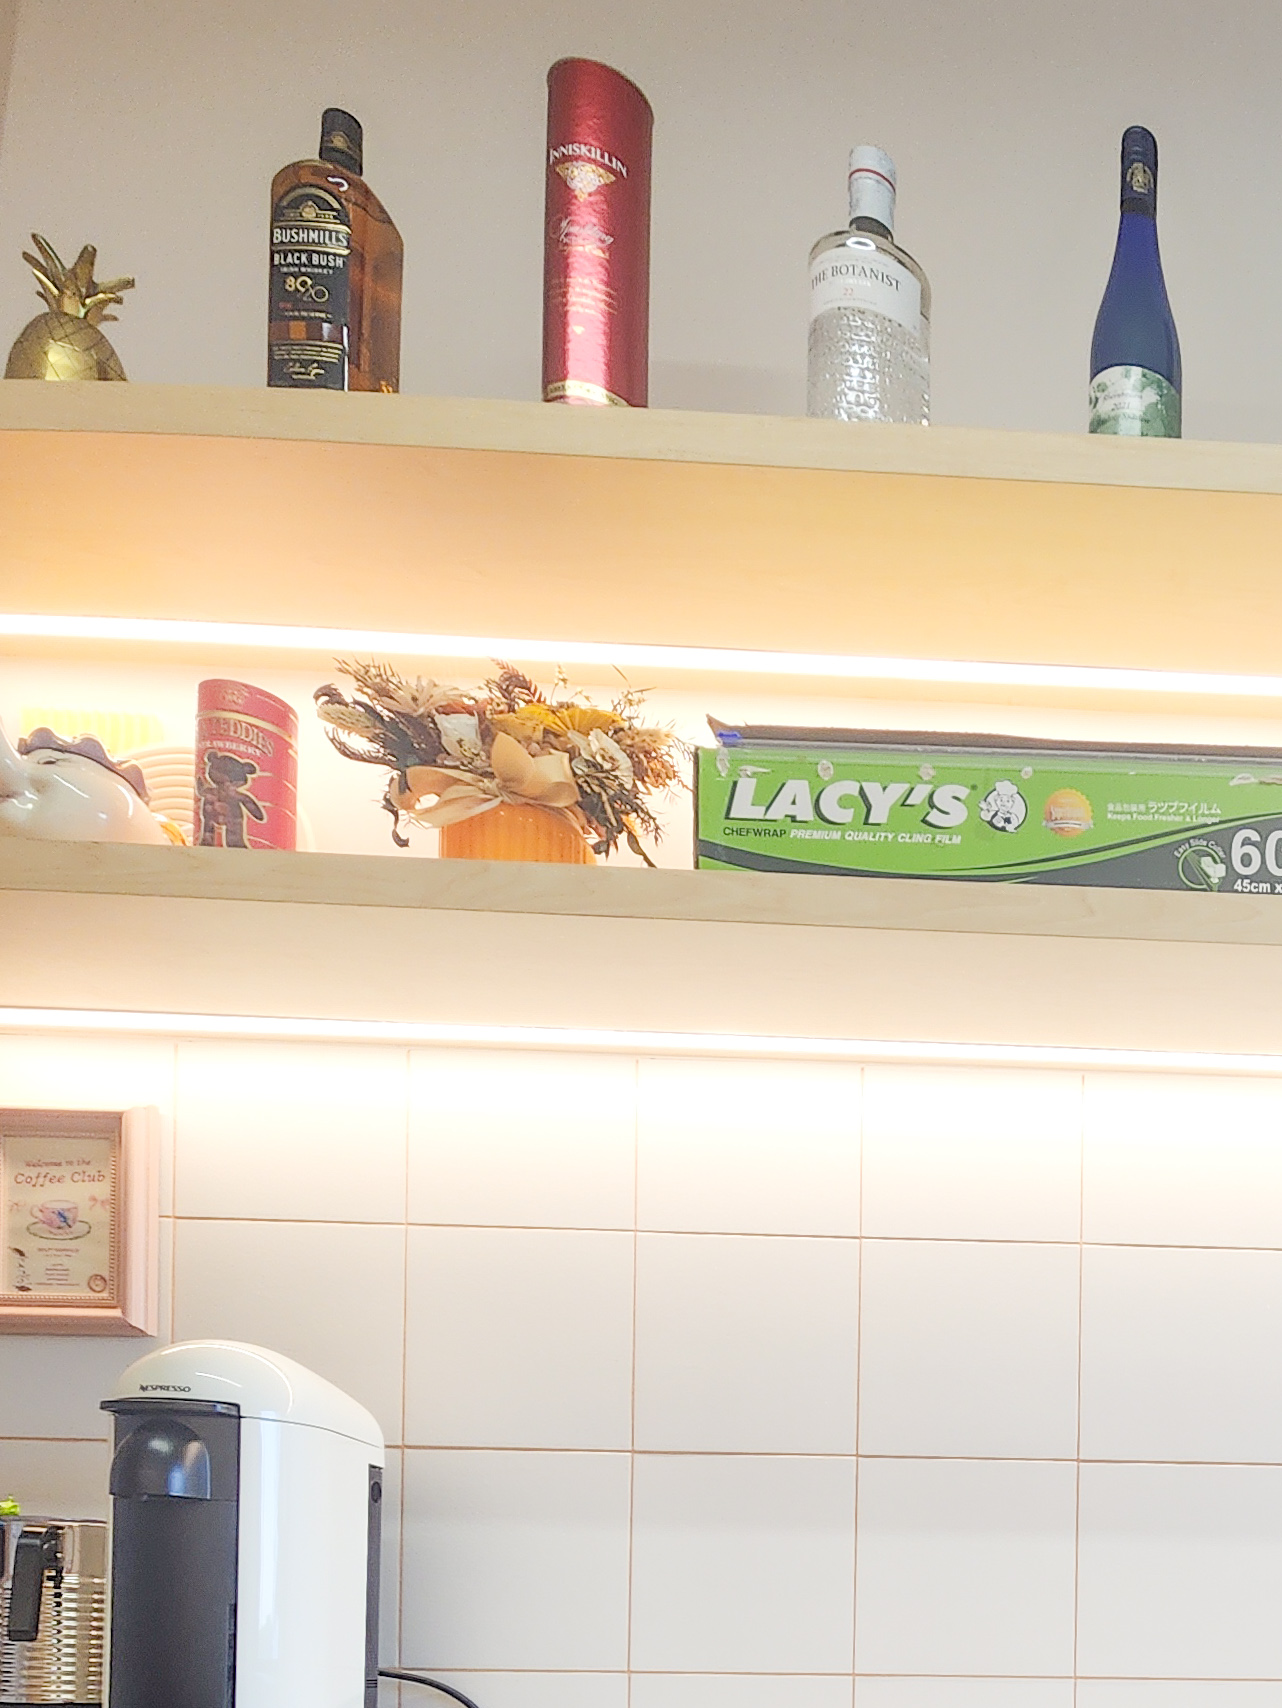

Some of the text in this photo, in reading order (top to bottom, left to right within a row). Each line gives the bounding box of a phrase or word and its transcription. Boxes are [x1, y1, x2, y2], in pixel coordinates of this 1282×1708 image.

[548, 143, 628, 179] INNISKILLIN
[272, 228, 349, 248] BUSHMILLS
[273, 252, 344, 269] BLACK BUSH
[831, 264, 900, 292] BOTANIST
[724, 777, 971, 829] LACY'S
[722, 826, 962, 844] CHEFWRAP PREMIUM QUALITY CLING FILM
[1233, 878, 1271, 893] 45cm
[14, 1169, 106, 1188] Coffee Club
[139, 1383, 192, 1393] NESPRESSO
